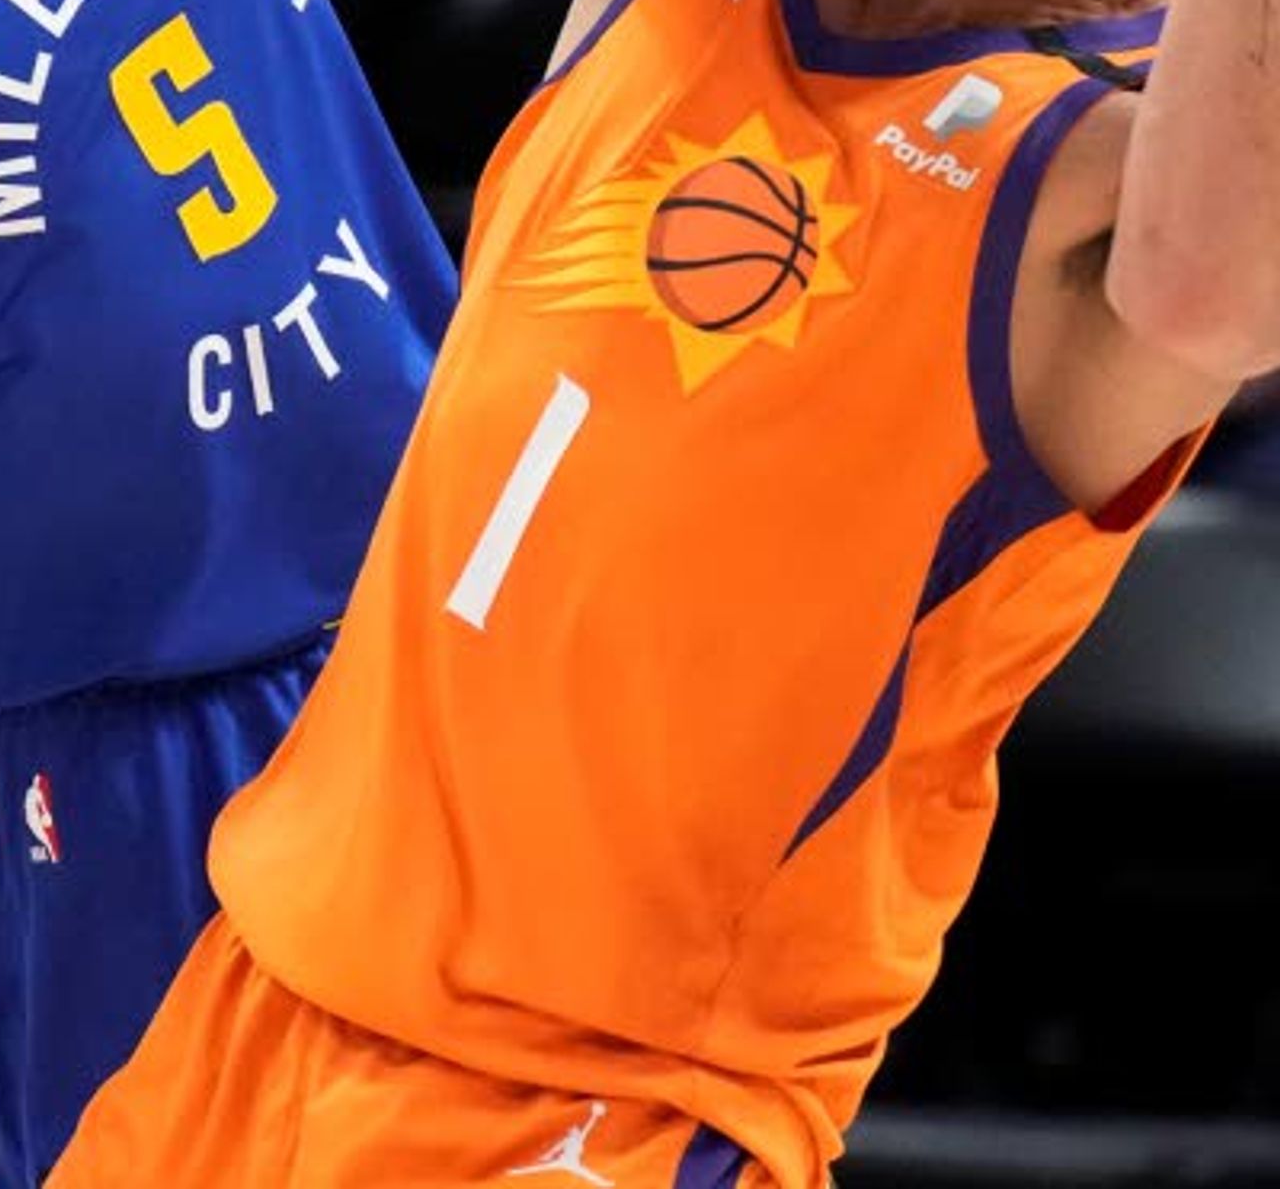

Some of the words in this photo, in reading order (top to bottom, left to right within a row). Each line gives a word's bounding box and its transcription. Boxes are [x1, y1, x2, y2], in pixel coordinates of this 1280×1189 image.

[110, 12, 279, 263] 5
[873, 123, 982, 191] PayPal
[186, 219, 390, 431] CITY
[444, 371, 590, 632] 1
